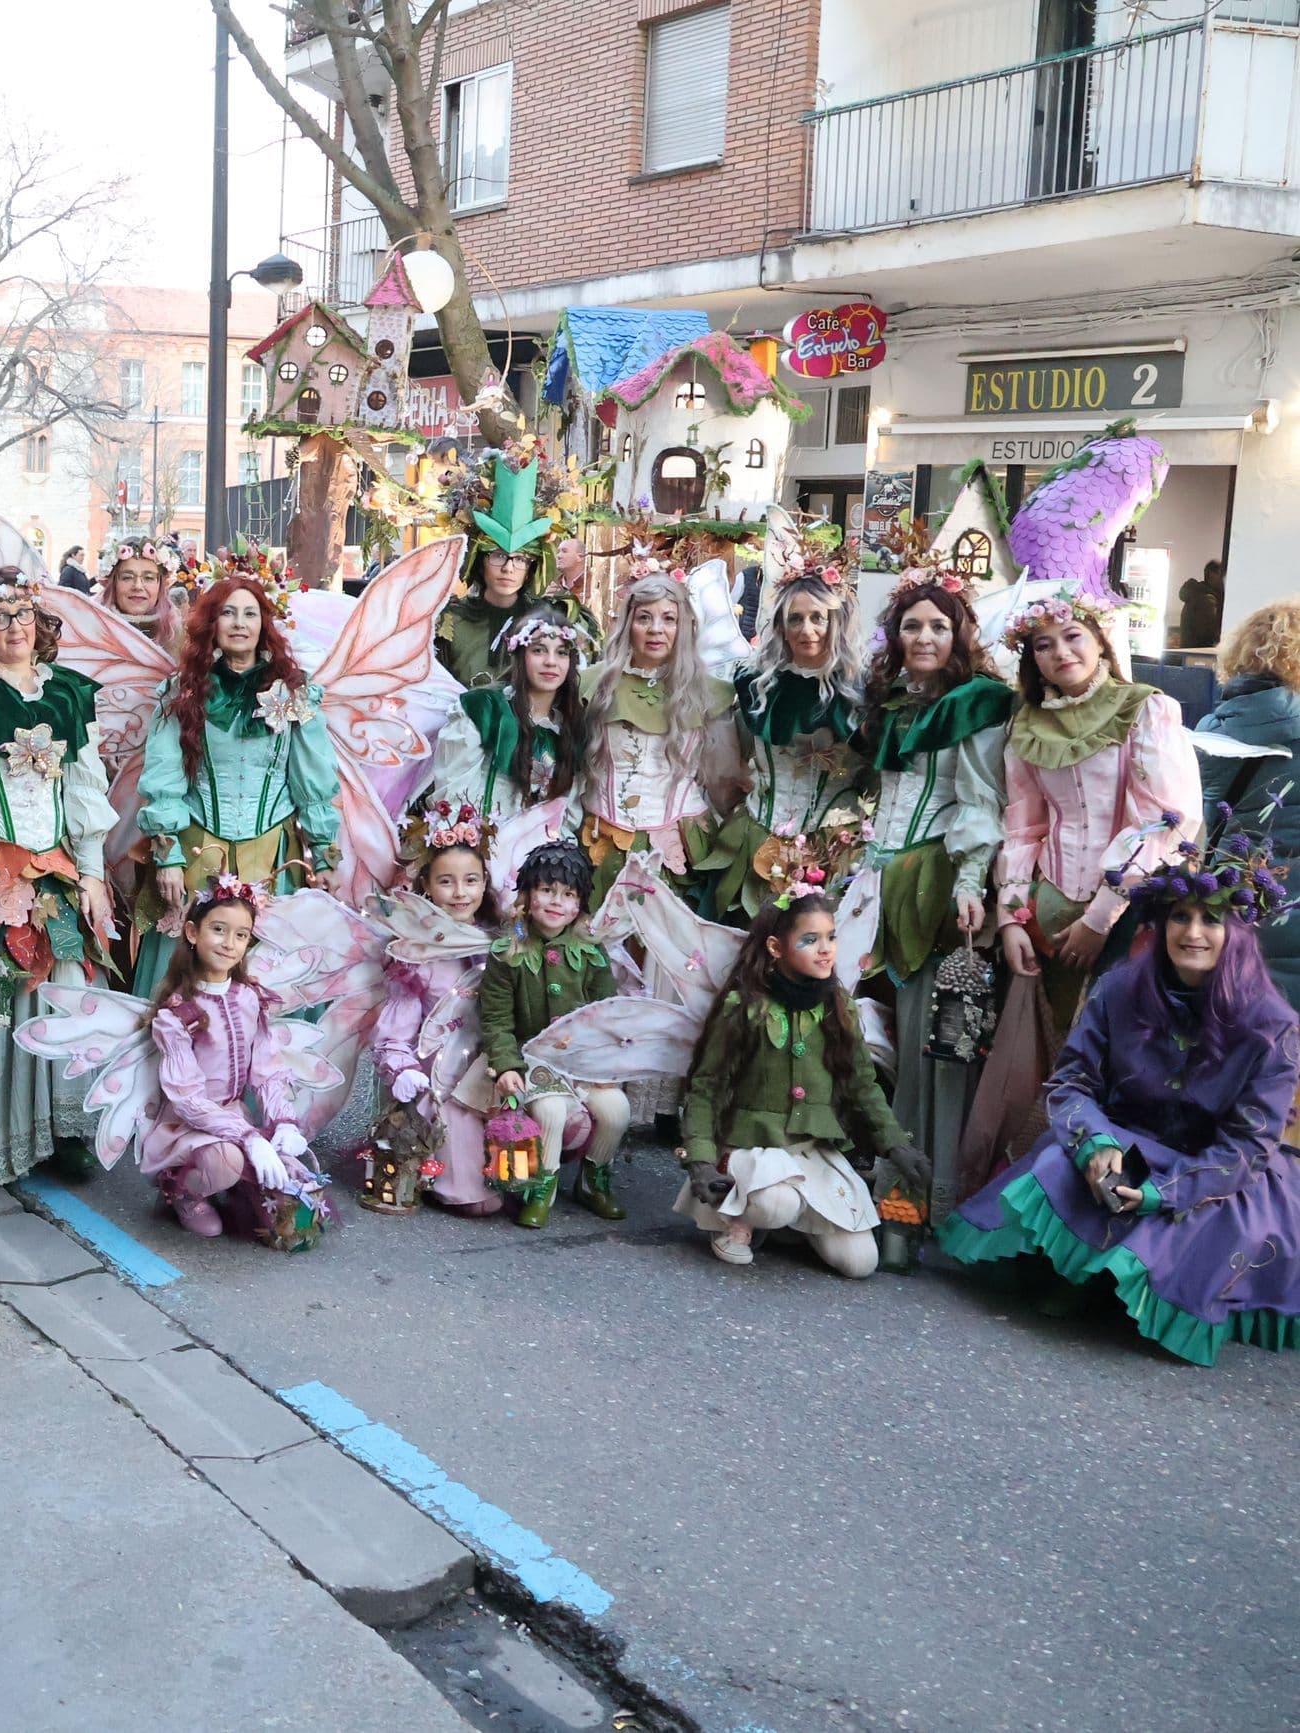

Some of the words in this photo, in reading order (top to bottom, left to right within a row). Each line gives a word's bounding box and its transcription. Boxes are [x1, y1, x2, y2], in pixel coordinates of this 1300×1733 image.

[807, 314, 840, 330] Café
[798, 327, 860, 360] Estudio
[866, 322, 881, 346] 2
[847, 353, 872, 368] Bar
[970, 366, 1107, 412] ESTUDIO
[1130, 363, 1159, 406] 2
[992, 440, 1075, 460] ESTUDIO
